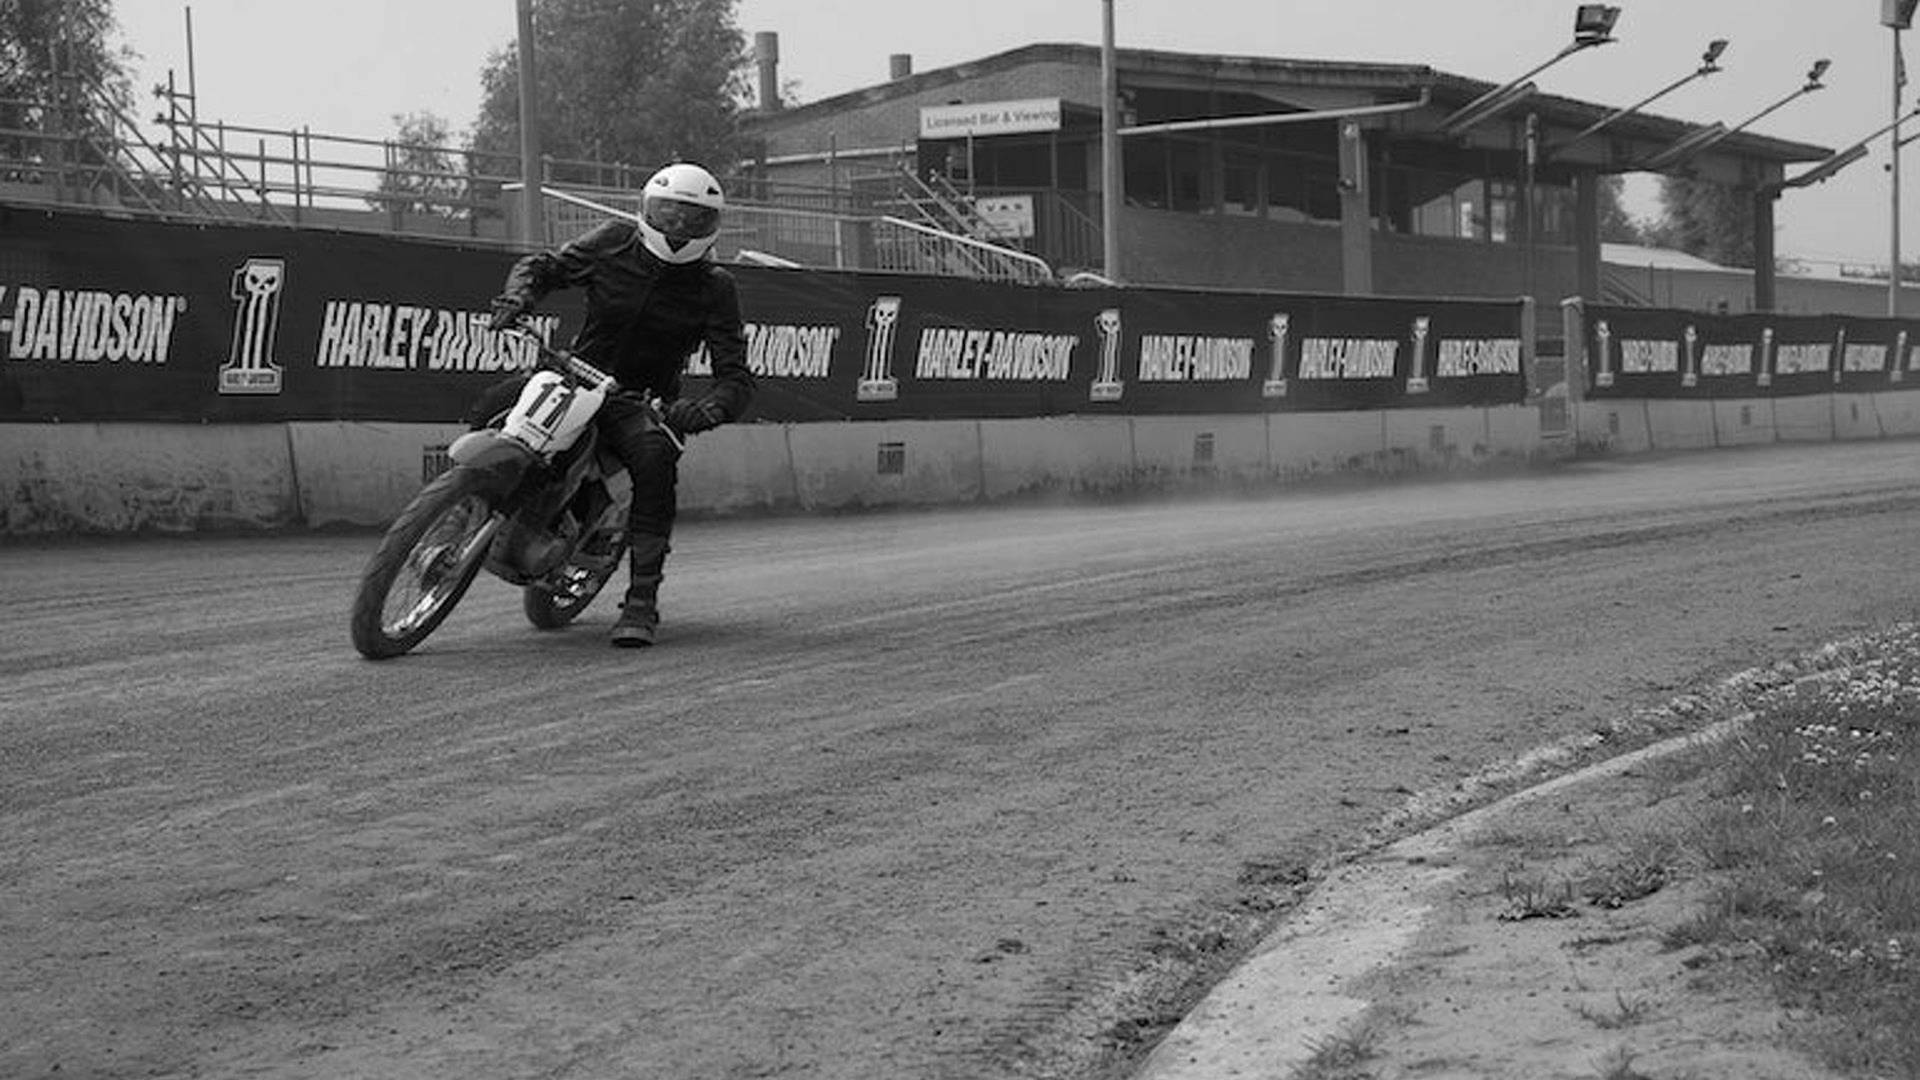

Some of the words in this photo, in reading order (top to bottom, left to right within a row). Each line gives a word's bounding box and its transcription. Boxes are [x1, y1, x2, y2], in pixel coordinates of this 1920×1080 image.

[980, 112, 1000, 125] Bar
[0, 286, 175, 362] -DAVIDSON
[916, 328, 1075, 380] HARLEY-DAVIDSON
